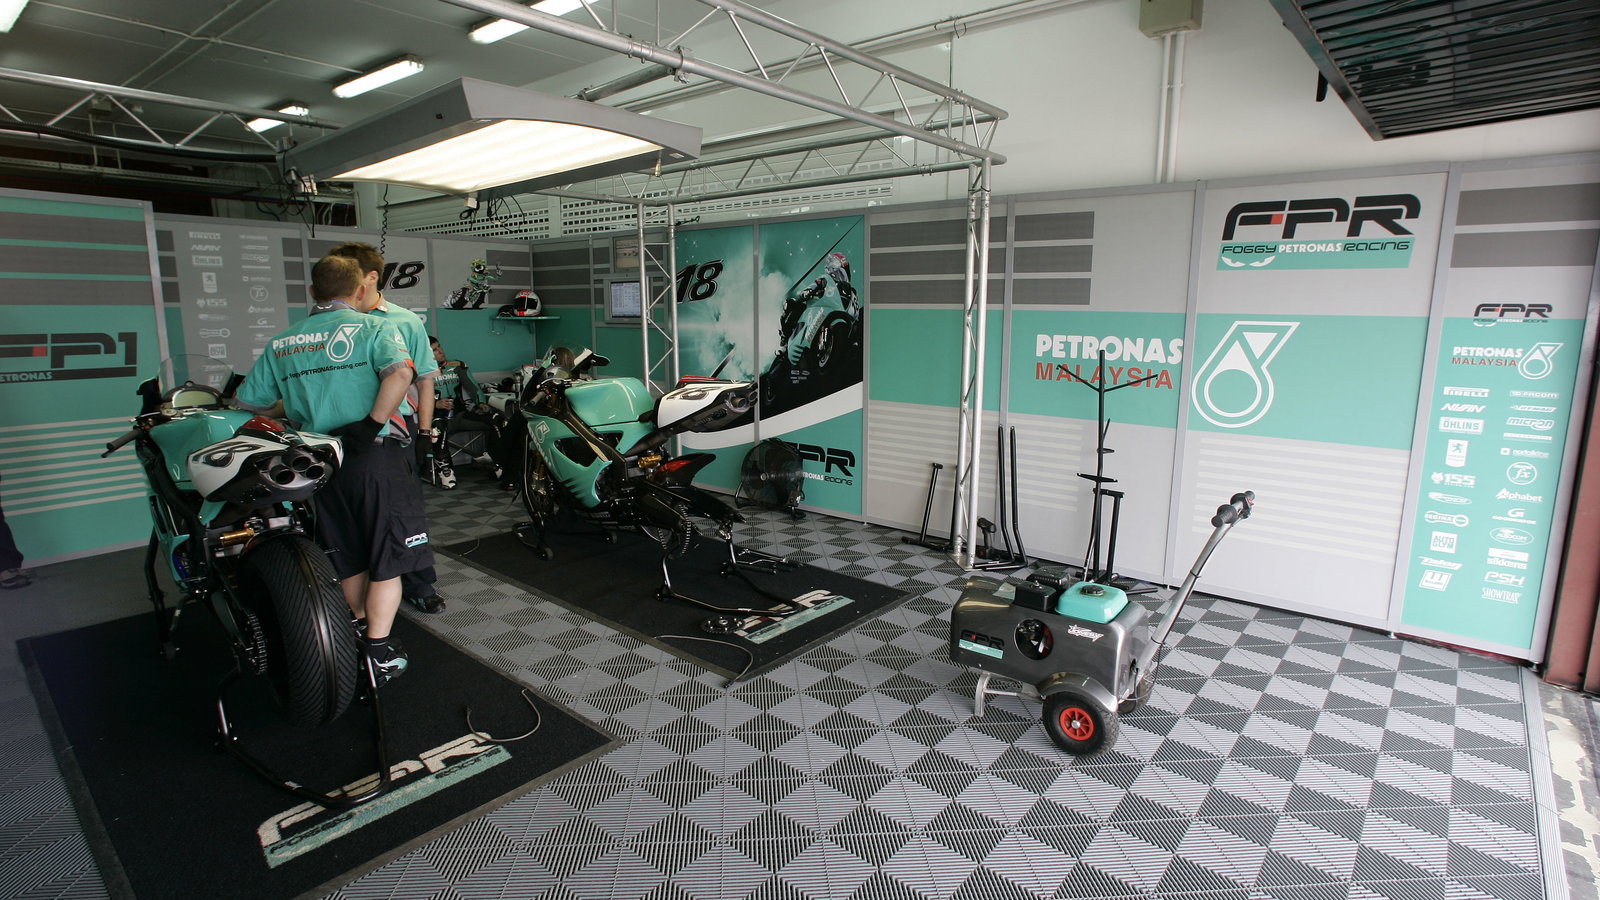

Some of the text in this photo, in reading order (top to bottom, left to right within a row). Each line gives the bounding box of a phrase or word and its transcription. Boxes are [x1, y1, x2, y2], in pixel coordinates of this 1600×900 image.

[1222, 194, 1421, 241] FPR
[1222, 241, 1410, 254] FOGGY PETRONAS RACING
[676, 259, 724, 304] 18
[1474, 304, 1552, 318] FPR
[272, 332, 329, 350] PETRONAS
[275, 343, 325, 359] MALAYSIA
[1036, 334, 1183, 364] PETRONAS
[1453, 346, 1523, 358] PETRONAS
[1452, 357, 1517, 367] MALAYSIA
[0, 371, 52, 382] ETRONAS
[1036, 362, 1173, 389] MALAYSIA
[802, 471, 824, 481] TRONAS
[1444, 473, 1476, 485] 155
[1495, 488, 1543, 502] Alphabet
[1484, 571, 1525, 586] PSH
